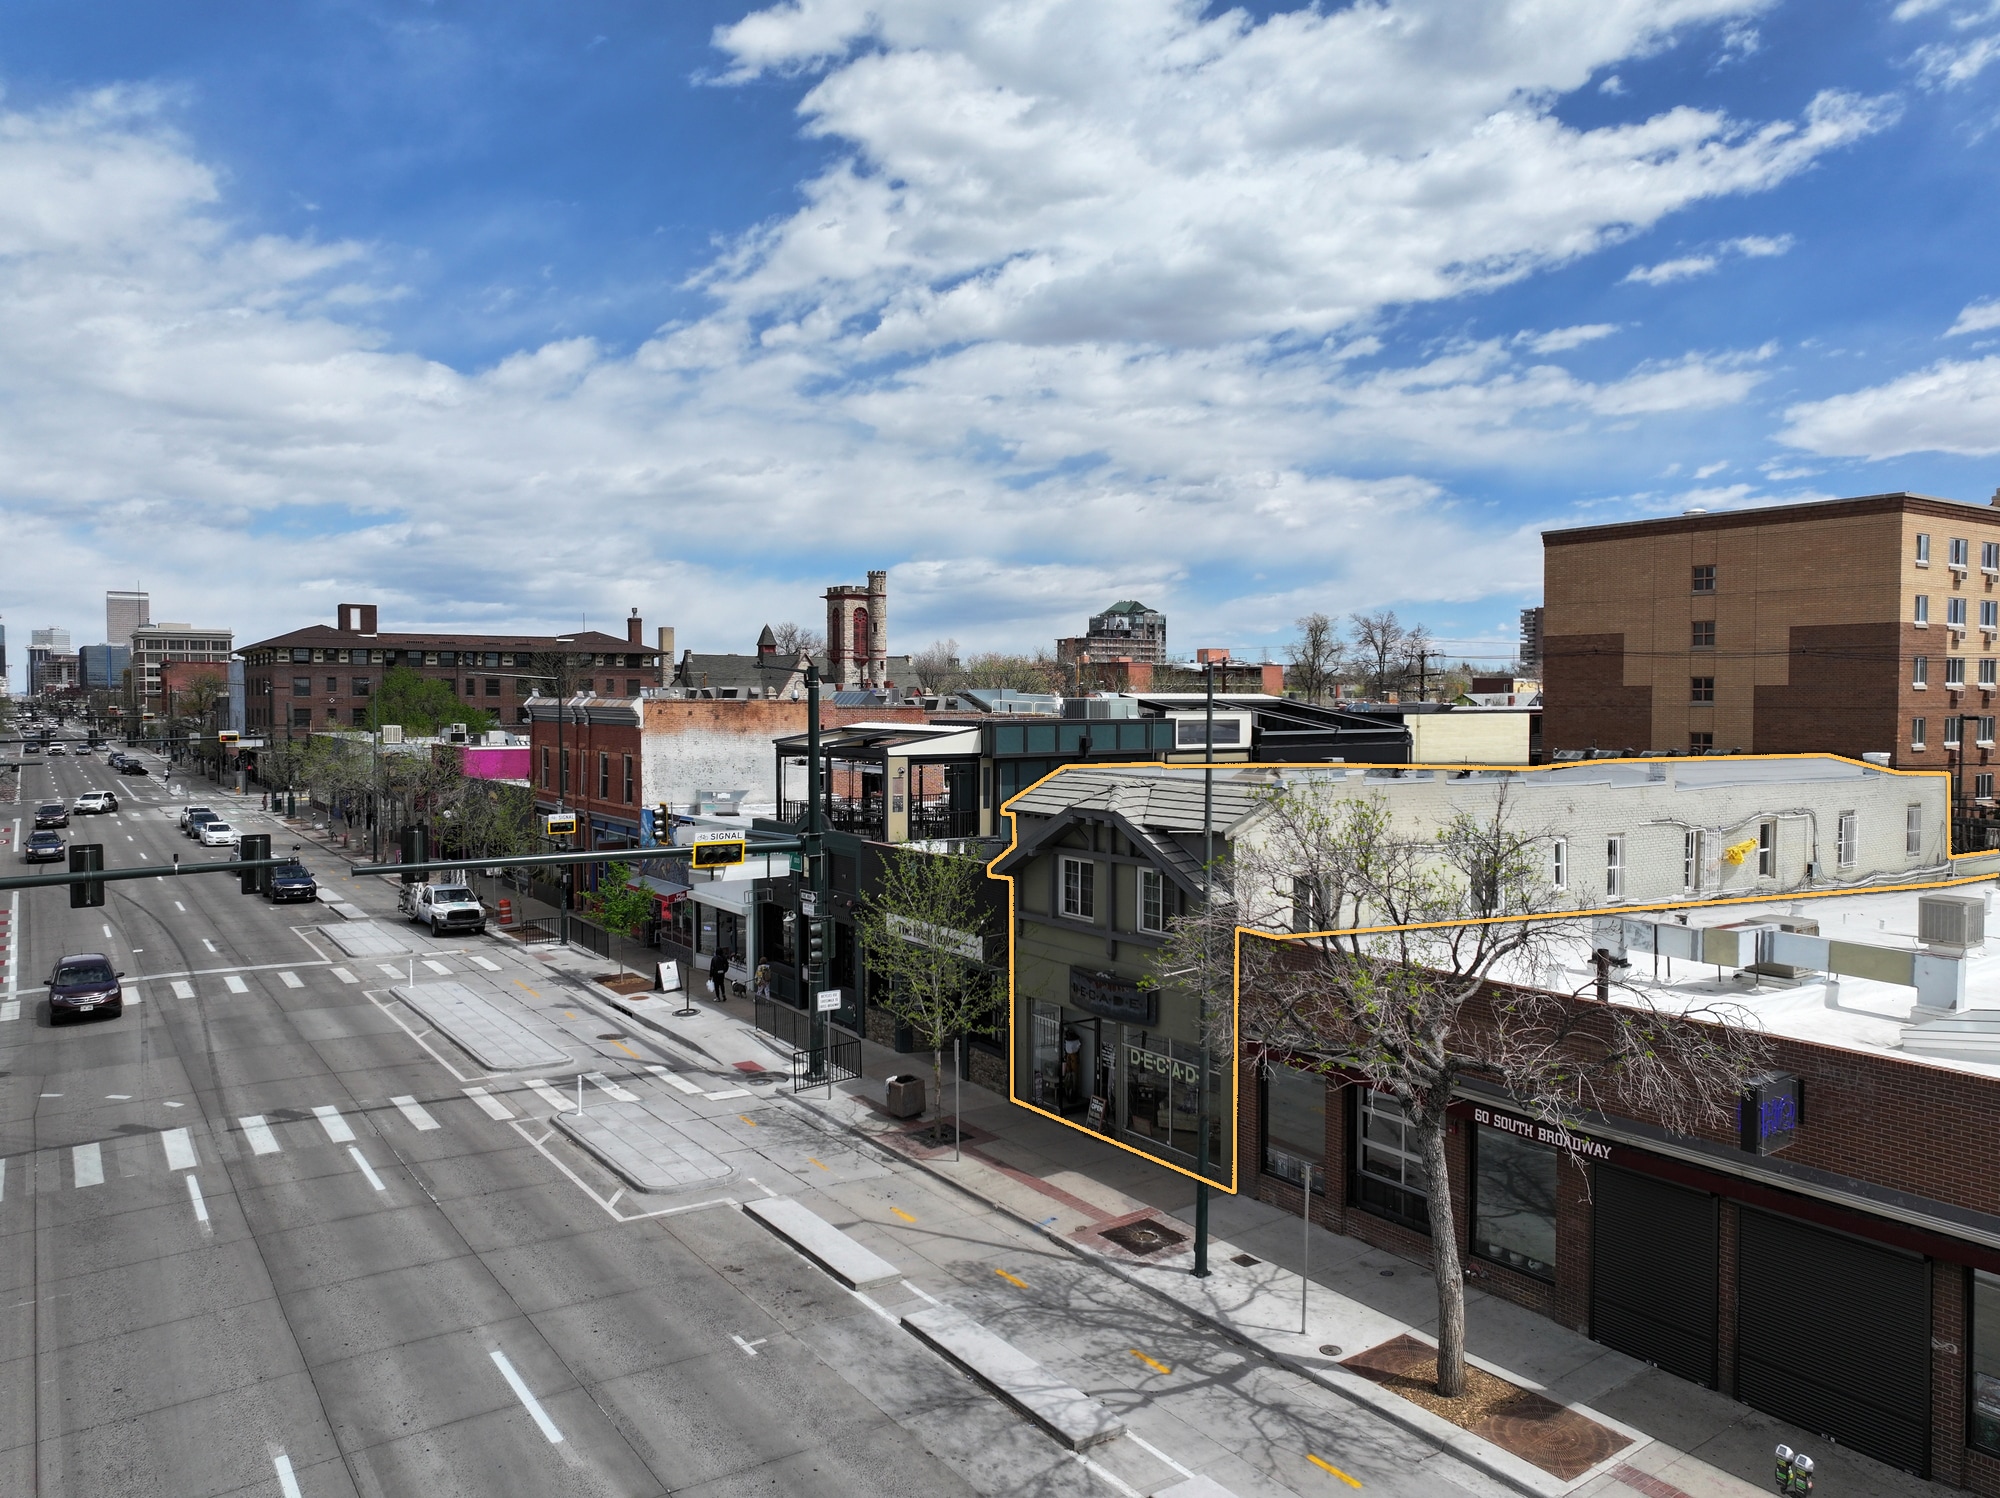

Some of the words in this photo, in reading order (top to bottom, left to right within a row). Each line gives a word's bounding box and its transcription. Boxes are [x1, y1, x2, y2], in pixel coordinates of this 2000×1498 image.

[710, 832, 742, 840] SIGNAL
[1474, 1108, 1489, 1124] 60
[1493, 1114, 1534, 1138] SOUTH
[1538, 1127, 1612, 1160] BROADWAY
